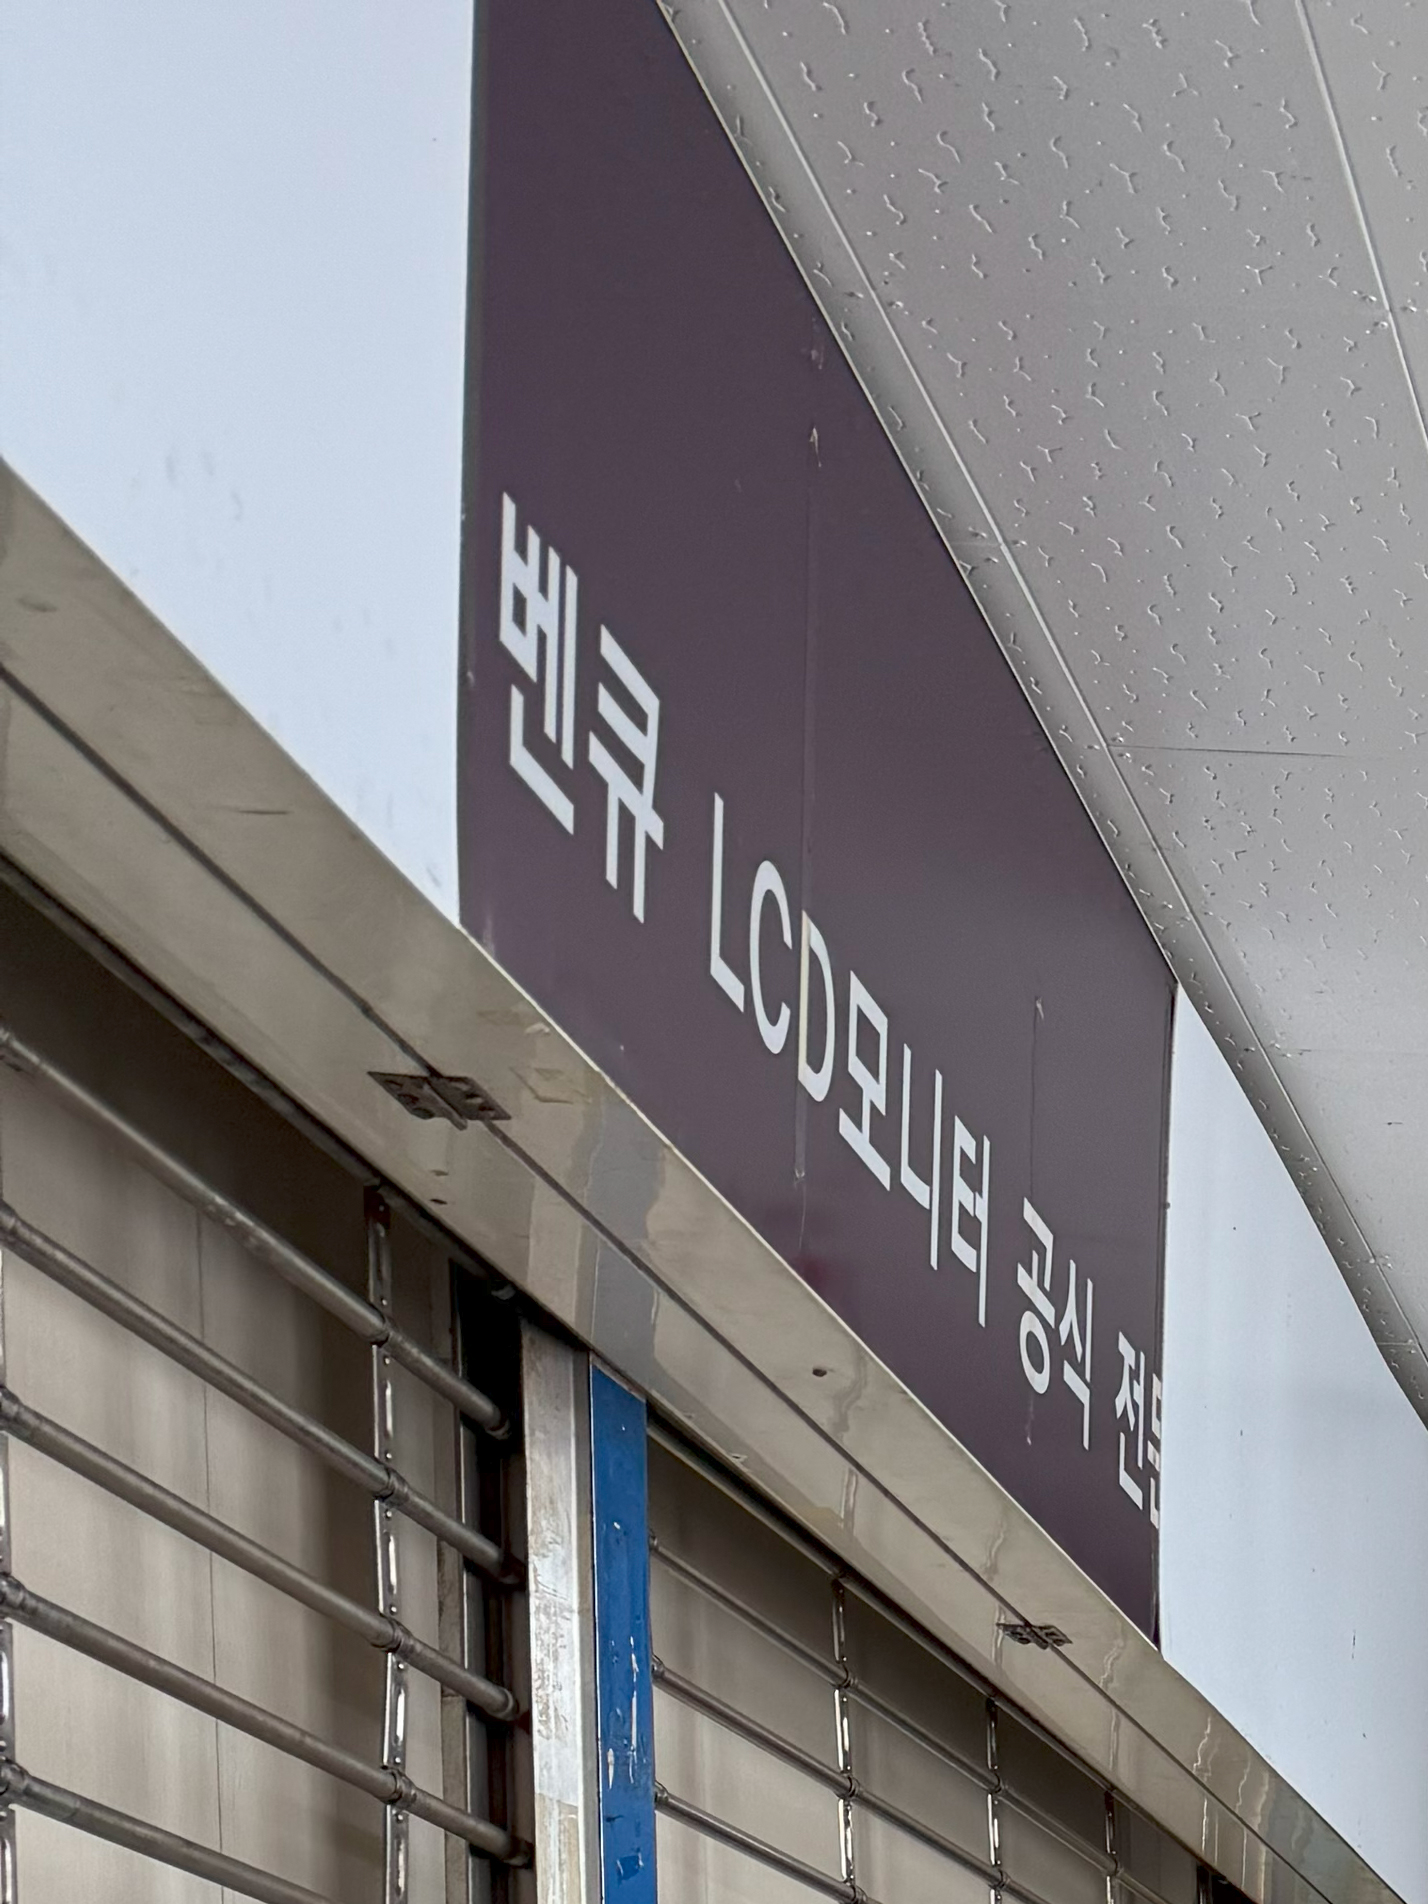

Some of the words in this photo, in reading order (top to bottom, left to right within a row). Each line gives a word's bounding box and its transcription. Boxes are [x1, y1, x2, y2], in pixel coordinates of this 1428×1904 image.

[500, 491, 665, 925] 벤큐
[708, 793, 990, 1327] LCD모니터
[1017, 1196, 1095, 1451] 공식
[1114, 1330, 1160, 1530] 전
